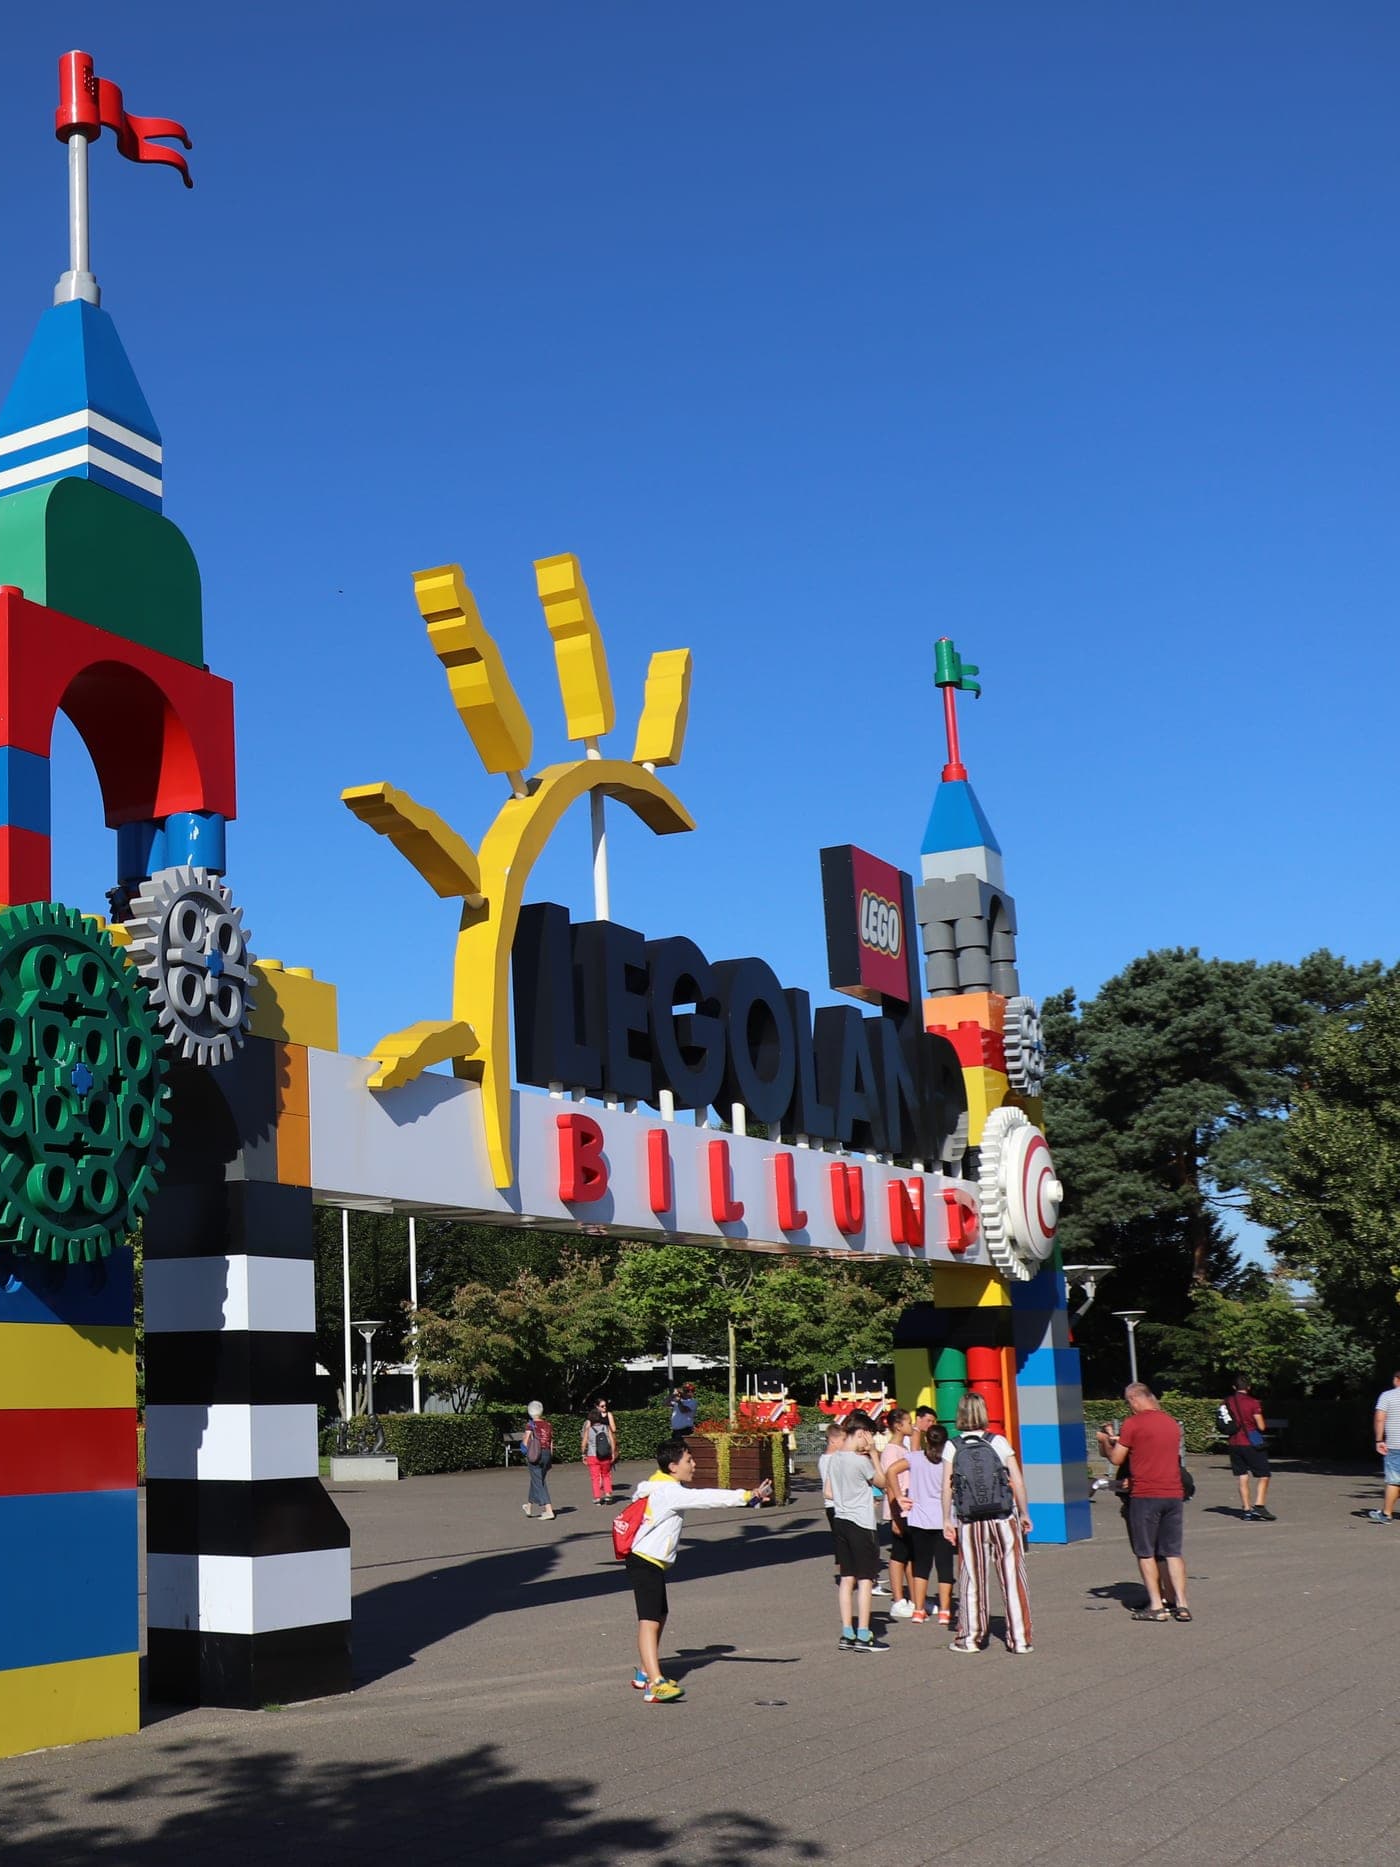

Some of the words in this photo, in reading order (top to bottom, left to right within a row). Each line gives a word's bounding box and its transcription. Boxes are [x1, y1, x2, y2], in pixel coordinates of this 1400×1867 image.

[860, 895, 899, 953] LEGO
[511, 901, 968, 1160] LEGOLAND
[557, 1113, 979, 1254] BILLUND
